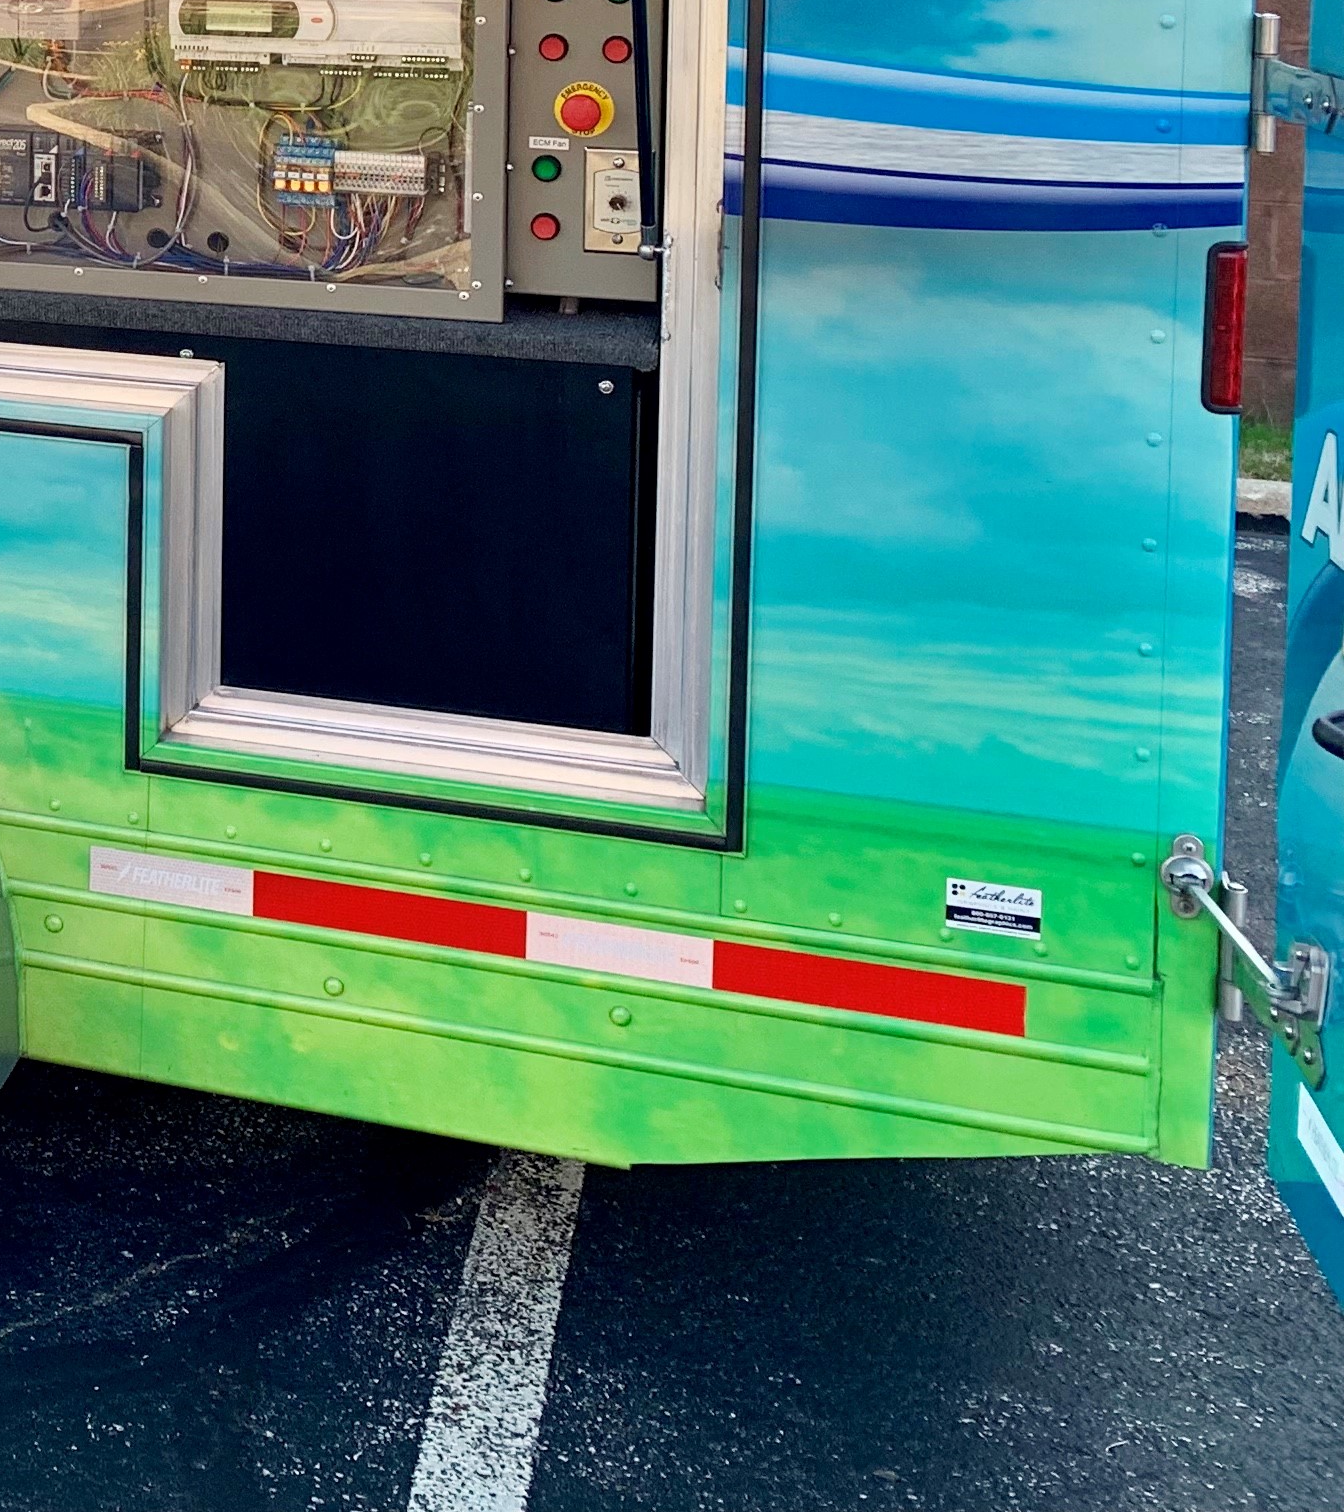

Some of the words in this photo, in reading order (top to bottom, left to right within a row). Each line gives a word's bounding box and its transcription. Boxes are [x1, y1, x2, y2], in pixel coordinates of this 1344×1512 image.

[560, 83, 610, 101] EMERGENCY
[533, 138, 551, 147] ECM
[553, 140, 567, 148] Fan
